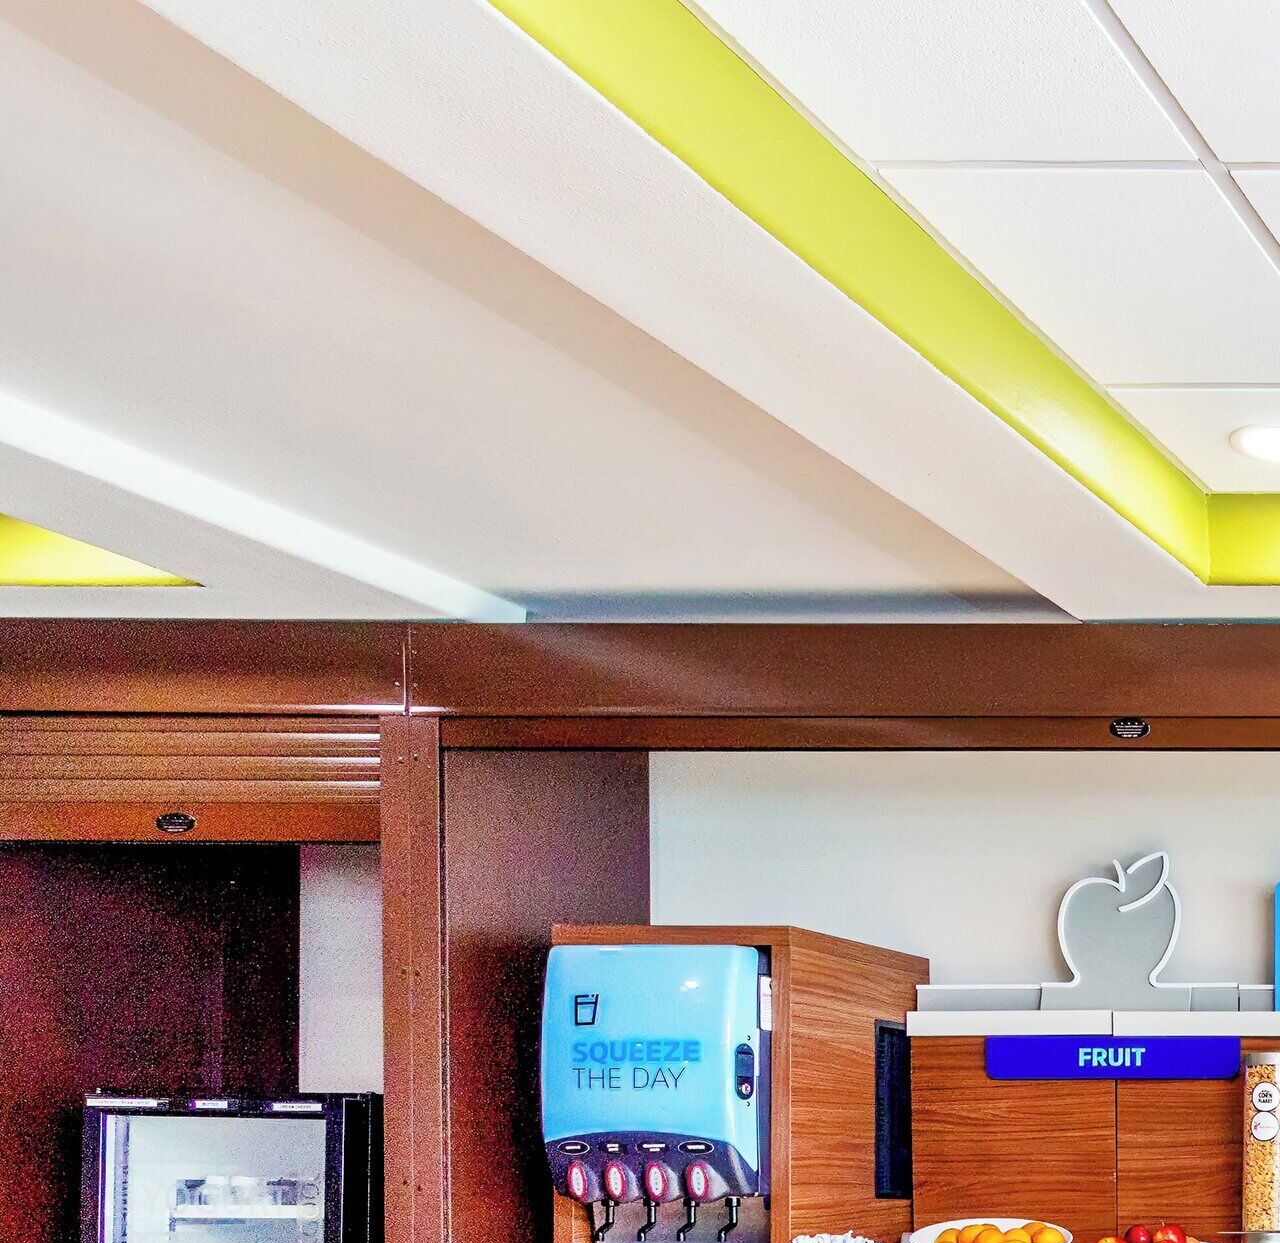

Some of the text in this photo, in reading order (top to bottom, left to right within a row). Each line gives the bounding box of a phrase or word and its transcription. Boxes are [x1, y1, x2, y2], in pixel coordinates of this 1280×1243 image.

[571, 1039, 701, 1064] SQUEEZE
[1078, 1047, 1146, 1067] FRUIT
[572, 1066, 686, 1089] THE DAY
